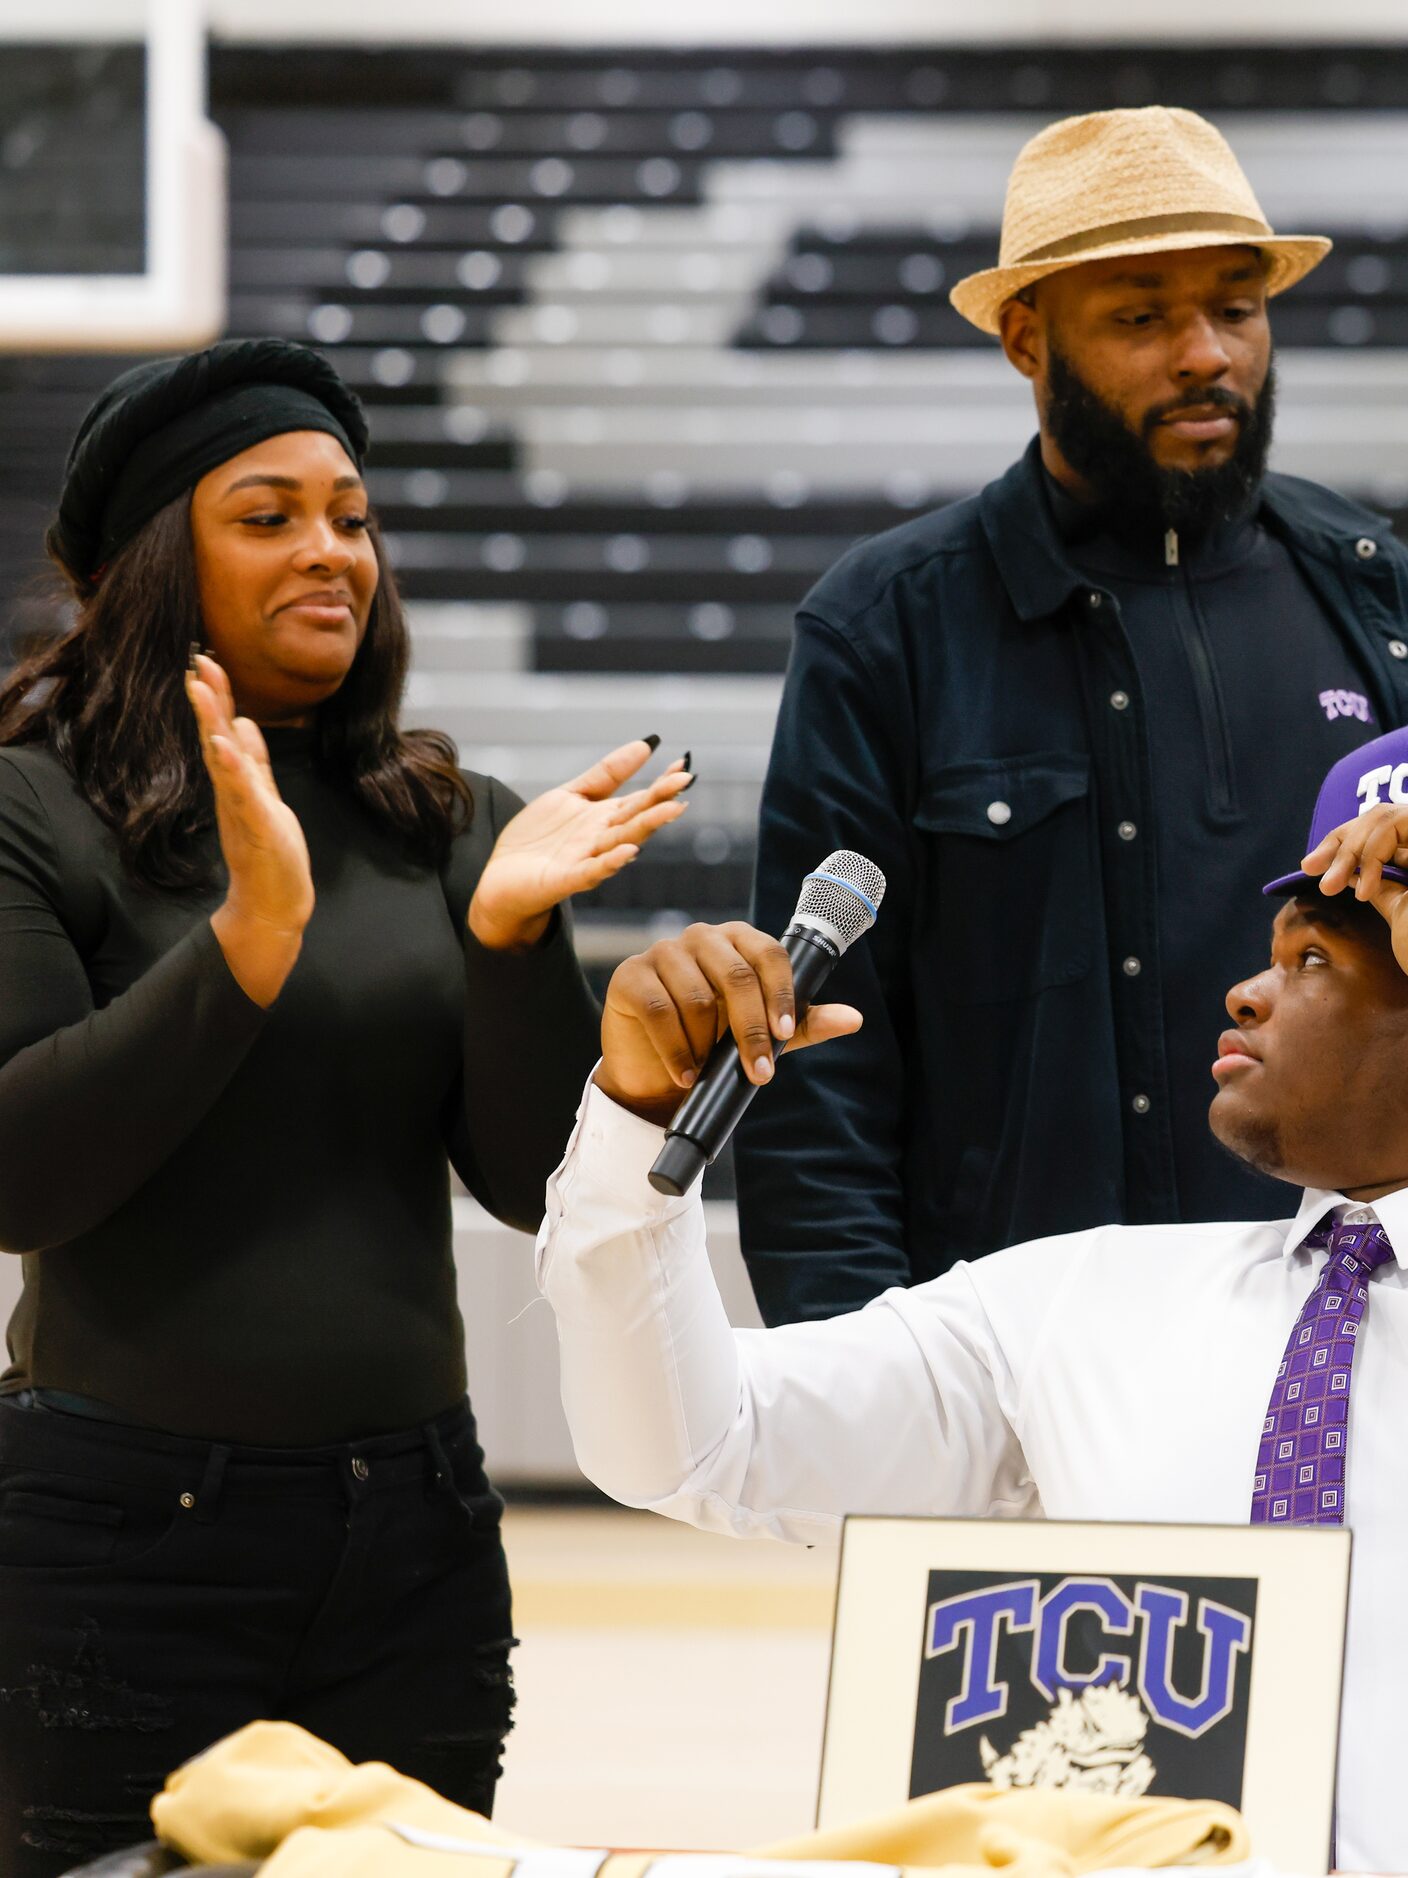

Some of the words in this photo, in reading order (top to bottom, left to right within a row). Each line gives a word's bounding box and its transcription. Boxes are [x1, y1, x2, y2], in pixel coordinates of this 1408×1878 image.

[1319, 689, 1374, 724] TCU
[812, 935, 837, 957] SHURE
[925, 1577, 1251, 1739] TCU
